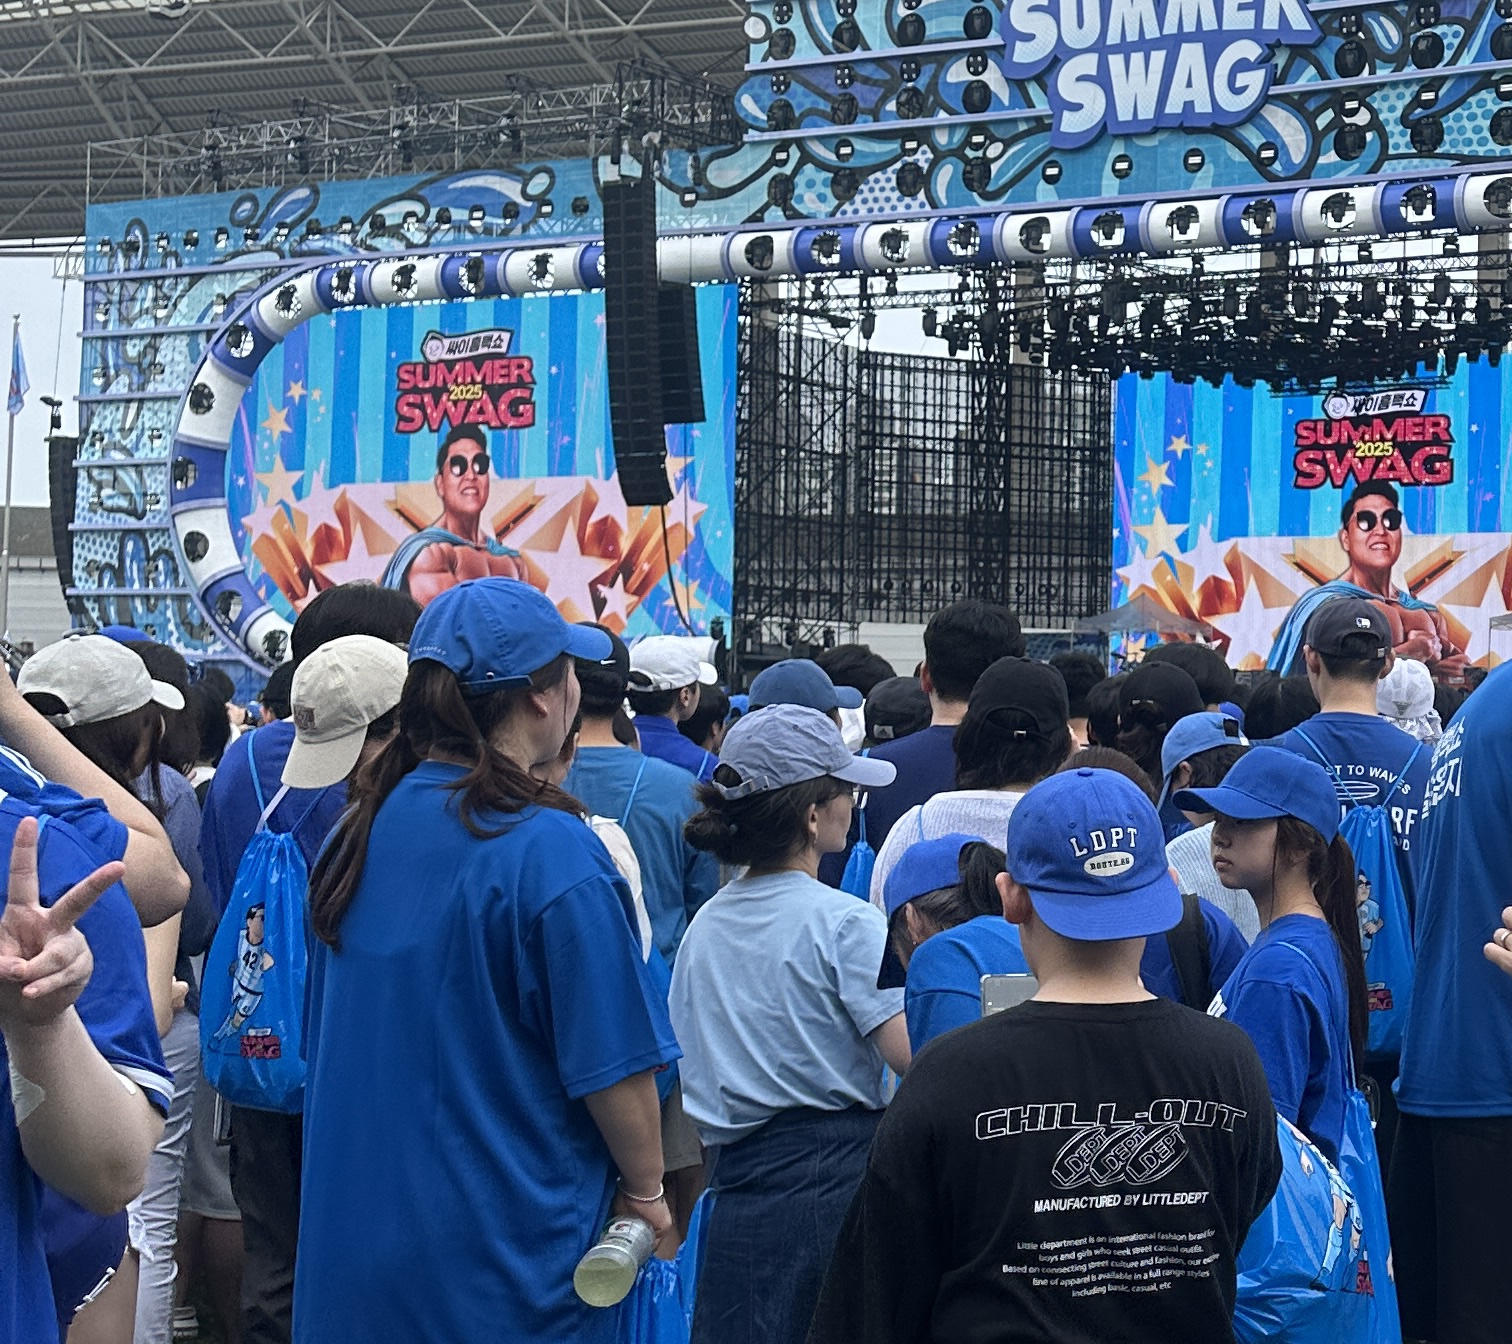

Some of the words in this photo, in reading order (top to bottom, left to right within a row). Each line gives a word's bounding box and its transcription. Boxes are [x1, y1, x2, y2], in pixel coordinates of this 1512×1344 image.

[1056, 39, 1266, 133] SWAG
[398, 358, 534, 389] SUMMER
[449, 384, 482, 400] 2025
[397, 388, 535, 432] SWAG
[1296, 416, 1451, 446] SUMMER
[1355, 442, 1394, 457] 2025
[1295, 446, 1452, 487] SWAG
[1347, 765, 1364, 775] TO
[1070, 827, 1138, 857] LDPT
[242, 950, 258, 970] 42
[975, 1099, 1247, 1140] CHILL-OUT
[1034, 1194, 1121, 1213] MANUFACTURED
[1123, 1194, 1141, 1206] BY
[1142, 1191, 1210, 1205] LITTLEDEPT
[1039, 1237, 1087, 1250] department
[1157, 1232, 1187, 1241] fashion
[1038, 1254, 1059, 1263] boys
[1059, 1251, 1076, 1261] and
[1093, 1247, 1111, 1256] who
[1113, 1247, 1131, 1256] seek
[1153, 1244, 1179, 1253] casual
[1002, 1264, 1028, 1274] Based
[1041, 1264, 1087, 1274] connecting
[1139, 1257, 1154, 1267] and
[1049, 1277, 1059, 1286] of
[1059, 1274, 1091, 1287] apparel
[1134, 1272, 1142, 1280] in
[1148, 1268, 1162, 1278] full
[1162, 1269, 1186, 1278] range
[1159, 1281, 1172, 1290] etc
